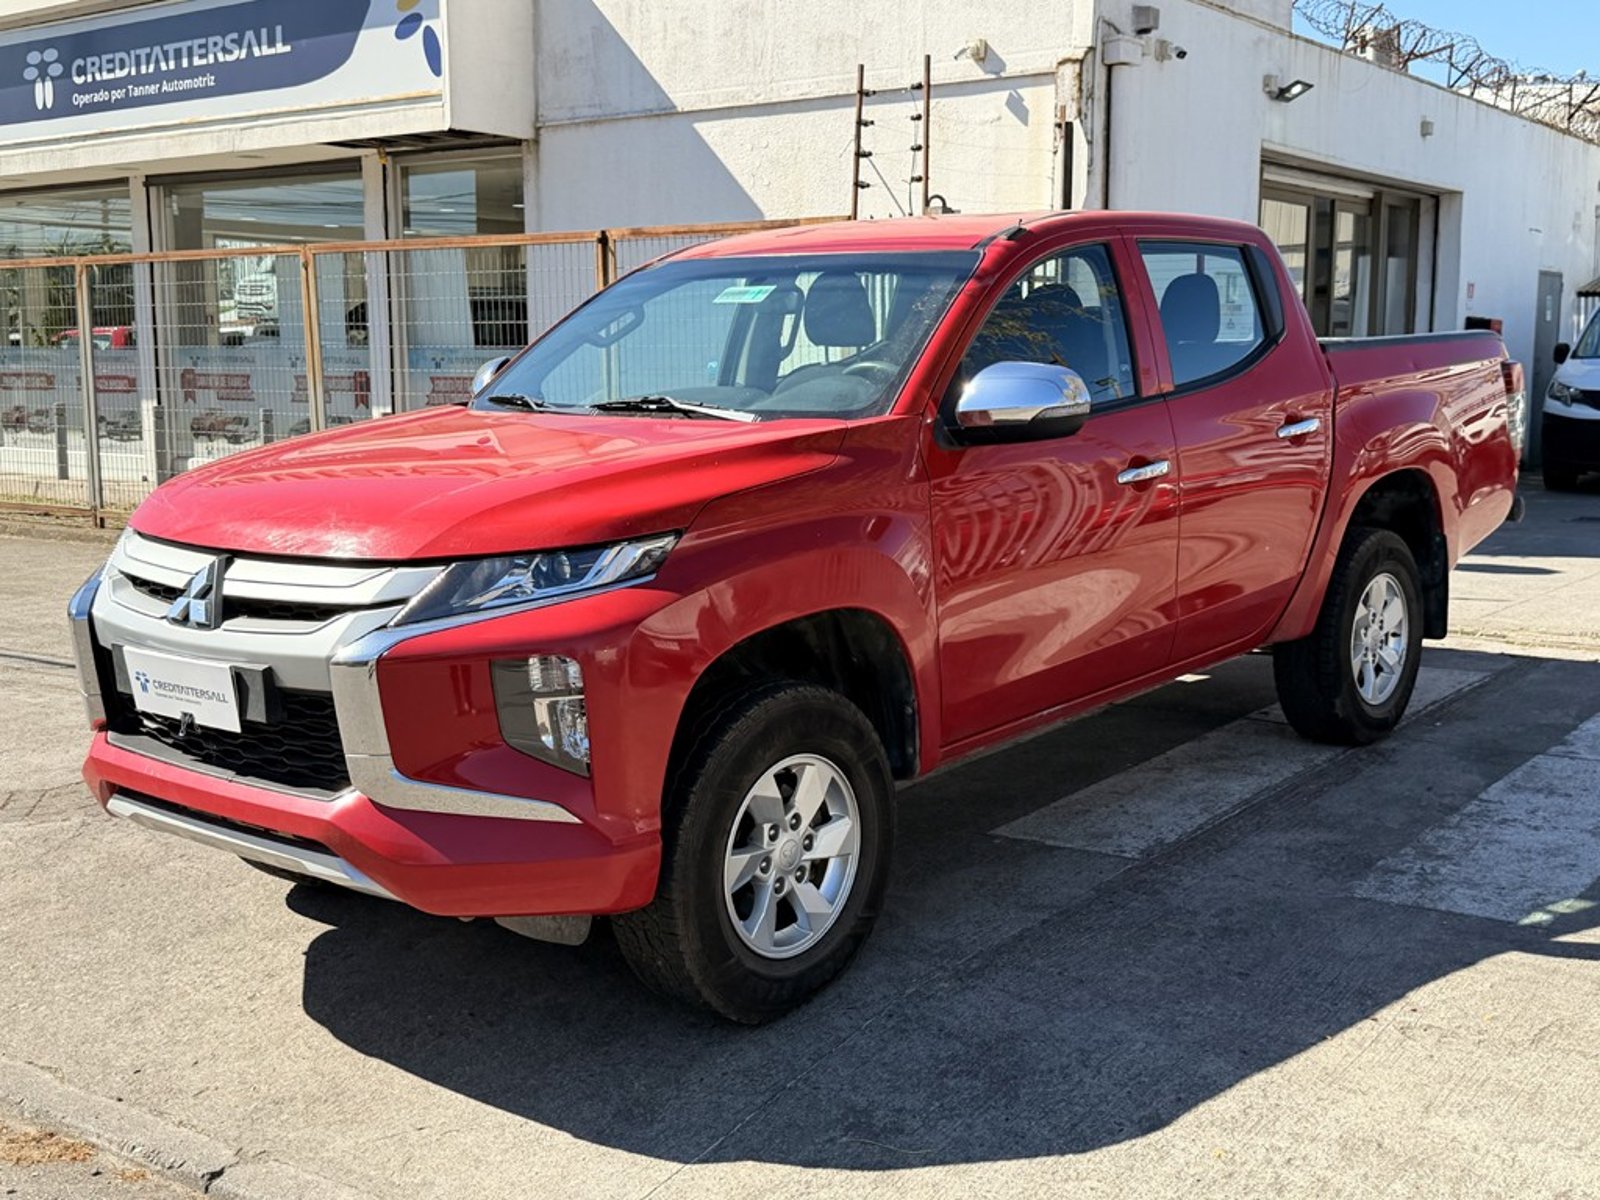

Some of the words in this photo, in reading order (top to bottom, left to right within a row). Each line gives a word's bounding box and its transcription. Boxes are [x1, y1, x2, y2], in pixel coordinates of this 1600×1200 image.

[72, 25, 291, 85] CREDITATTERSALL
[72, 89, 110, 108] Operado
[110, 88, 126, 103] por
[127, 83, 160, 97] Tanner
[162, 73, 216, 92] Automotriz
[153, 680, 229, 703] CREDITATTERSALL
